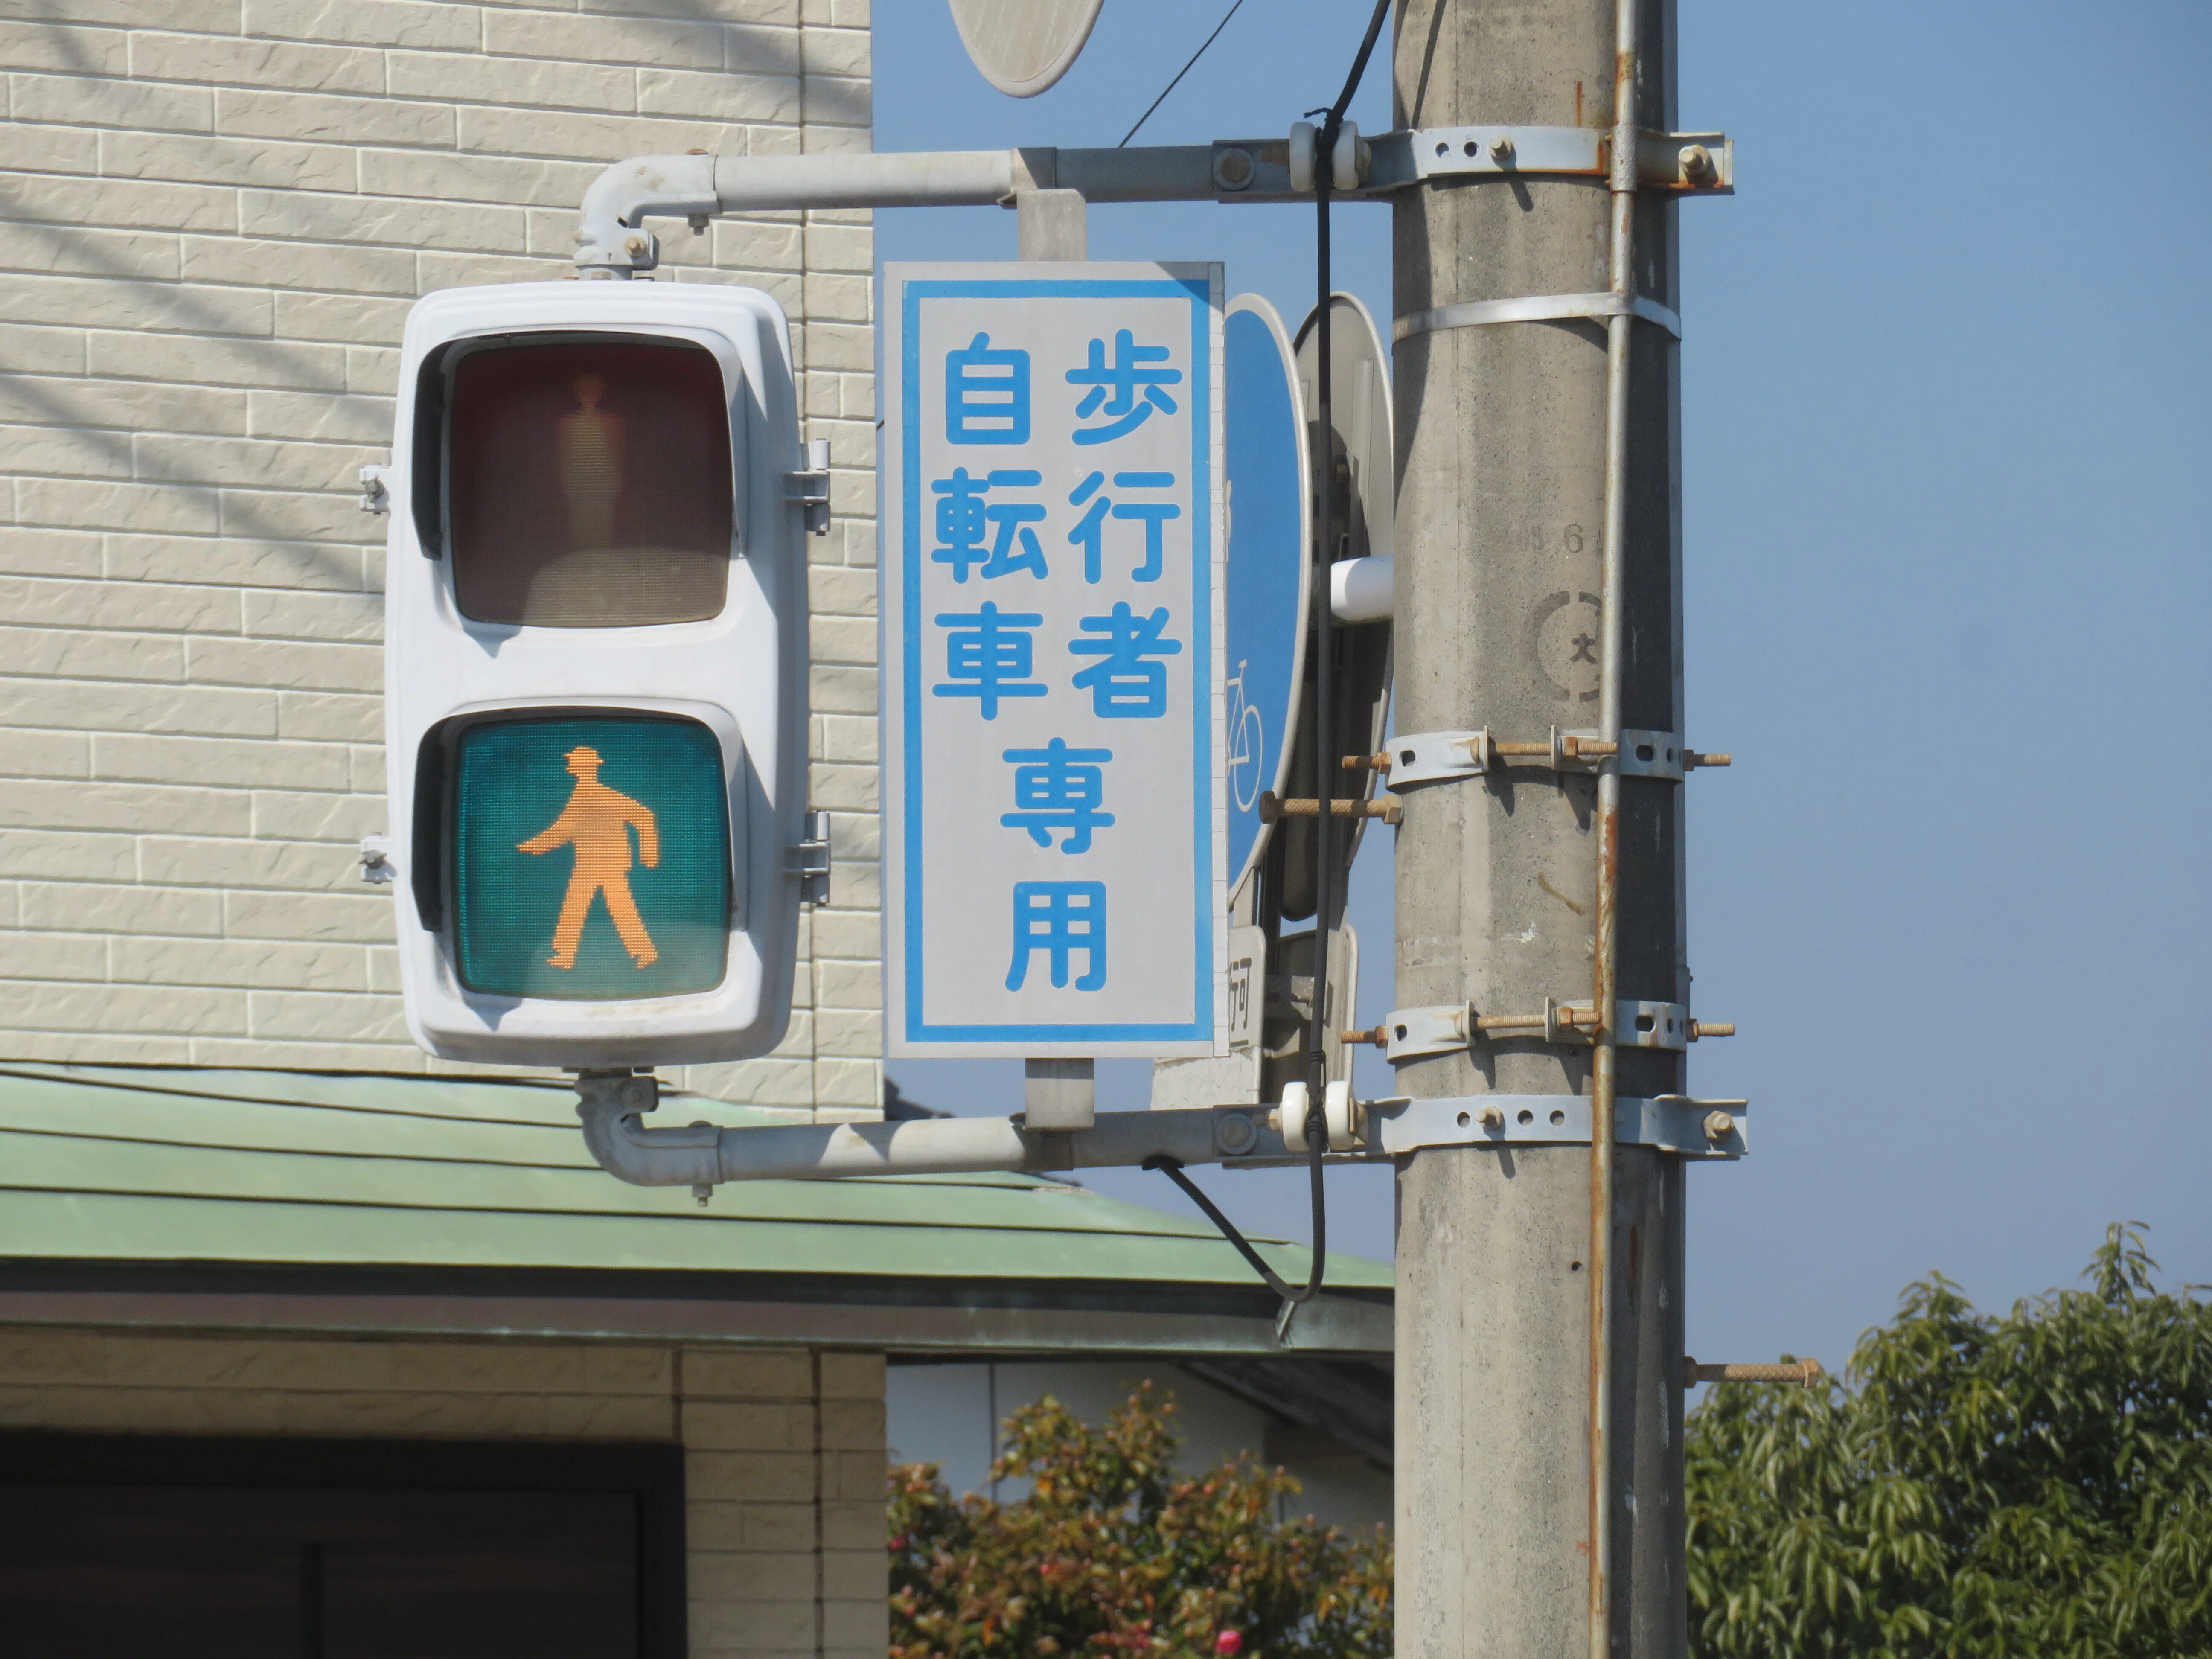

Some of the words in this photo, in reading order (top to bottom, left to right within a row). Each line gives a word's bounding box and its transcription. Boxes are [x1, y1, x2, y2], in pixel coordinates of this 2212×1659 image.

[931, 332, 1048, 720] 自転車
[1066, 329, 1182, 718] 歩行者
[1001, 738, 1115, 991] 専用
